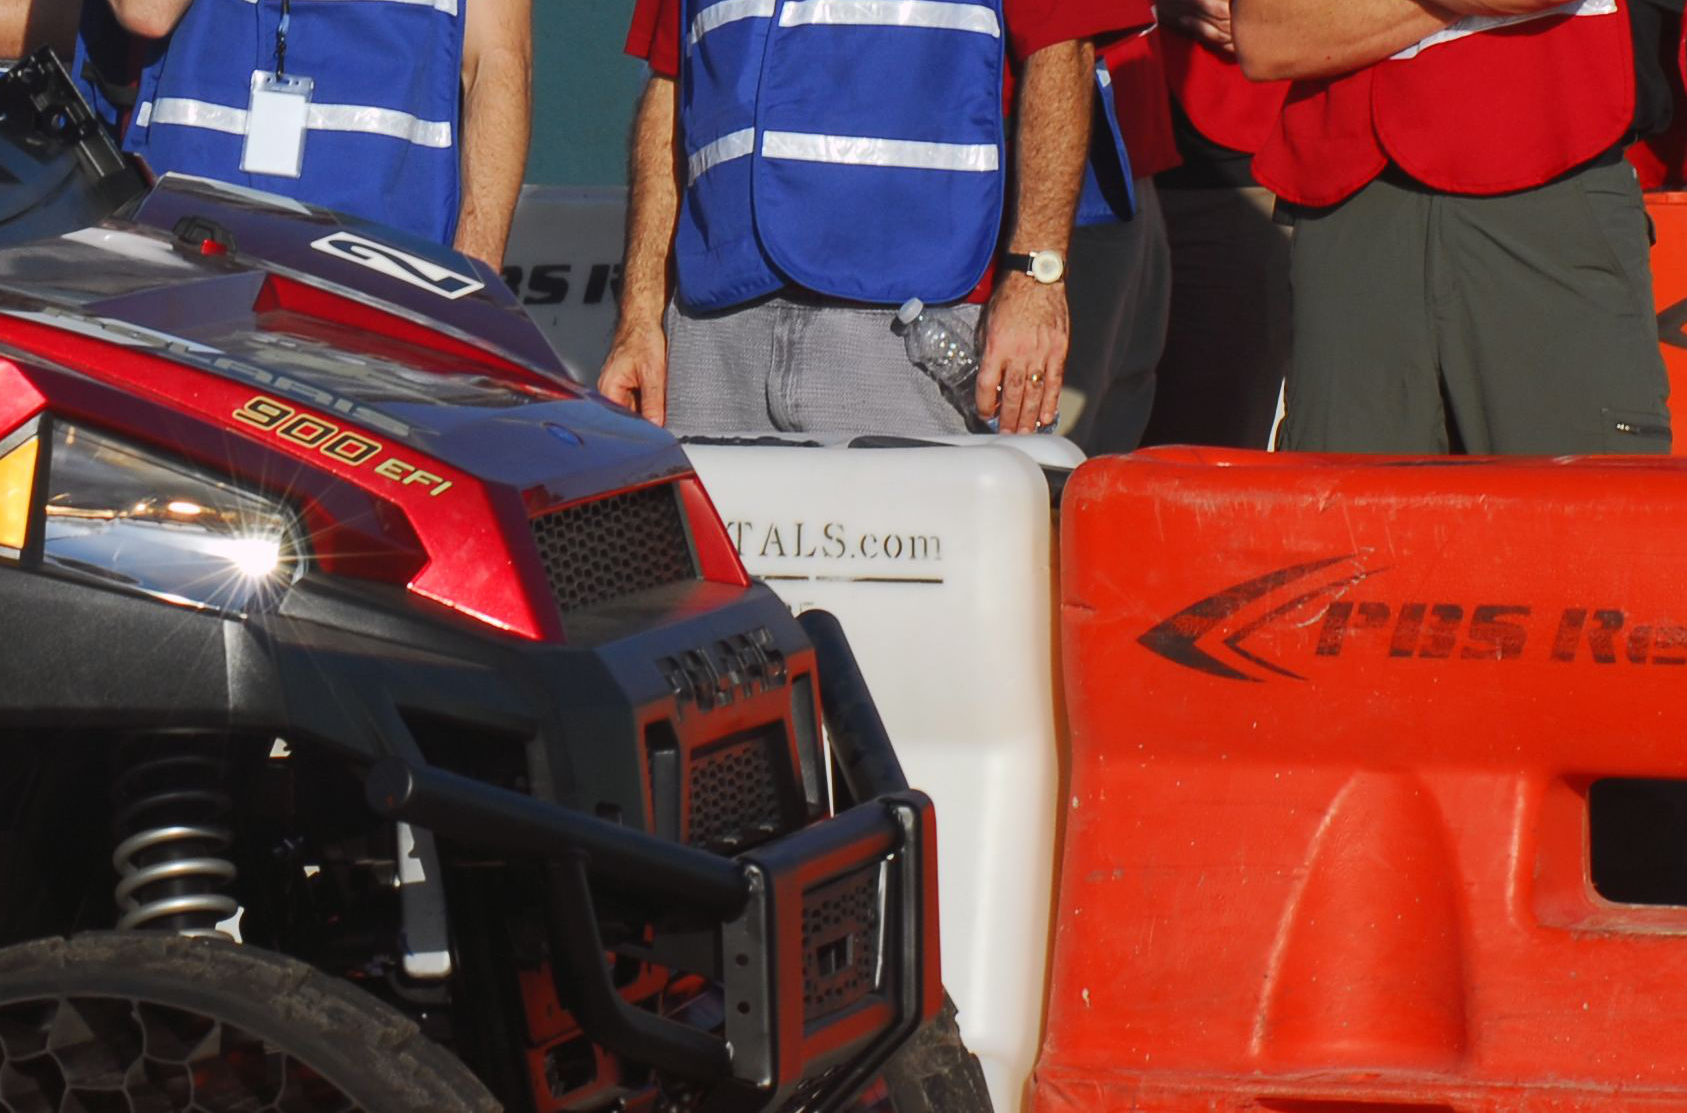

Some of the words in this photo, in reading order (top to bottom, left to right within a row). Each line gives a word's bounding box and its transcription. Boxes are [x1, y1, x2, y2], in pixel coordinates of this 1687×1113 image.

[232, 395, 383, 467] 900
[374, 457, 454, 498] EFI
[1315, 601, 1532, 660] PBS
